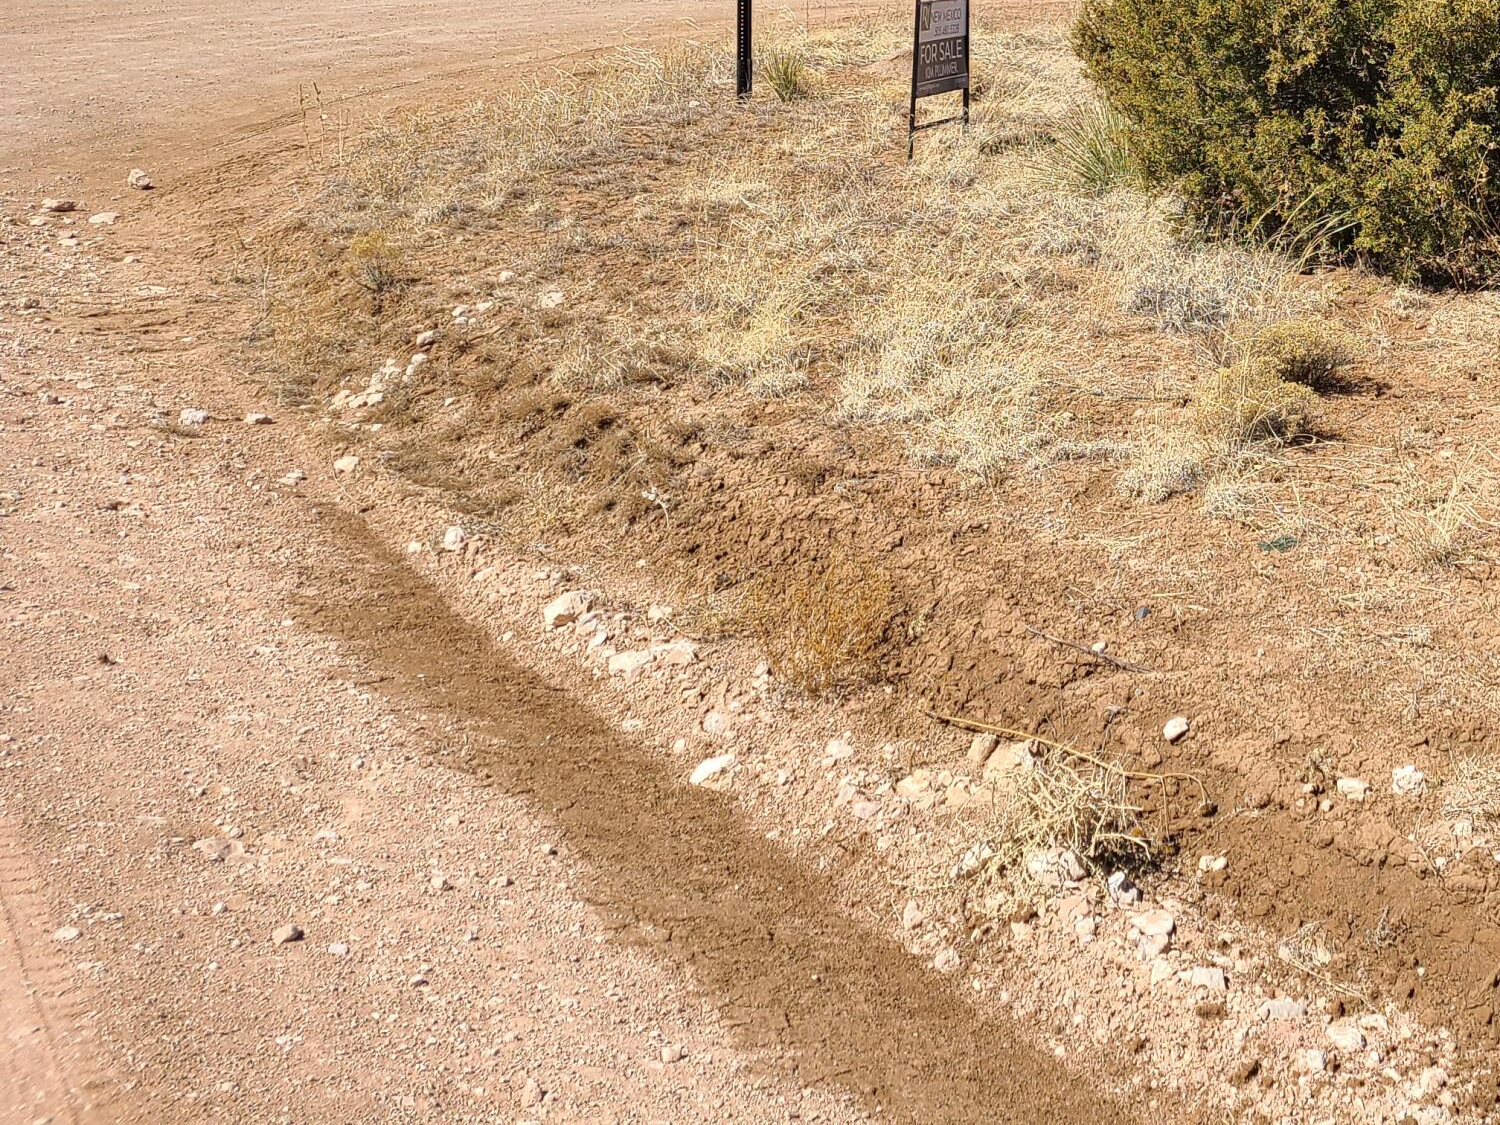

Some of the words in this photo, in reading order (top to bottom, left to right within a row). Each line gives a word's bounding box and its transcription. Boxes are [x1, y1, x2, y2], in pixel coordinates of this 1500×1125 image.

[931, 10, 942, 23] NEW
[942, 8, 961, 21] MEXICO
[920, 44, 938, 65] FOR
[939, 40, 962, 61] SALE
